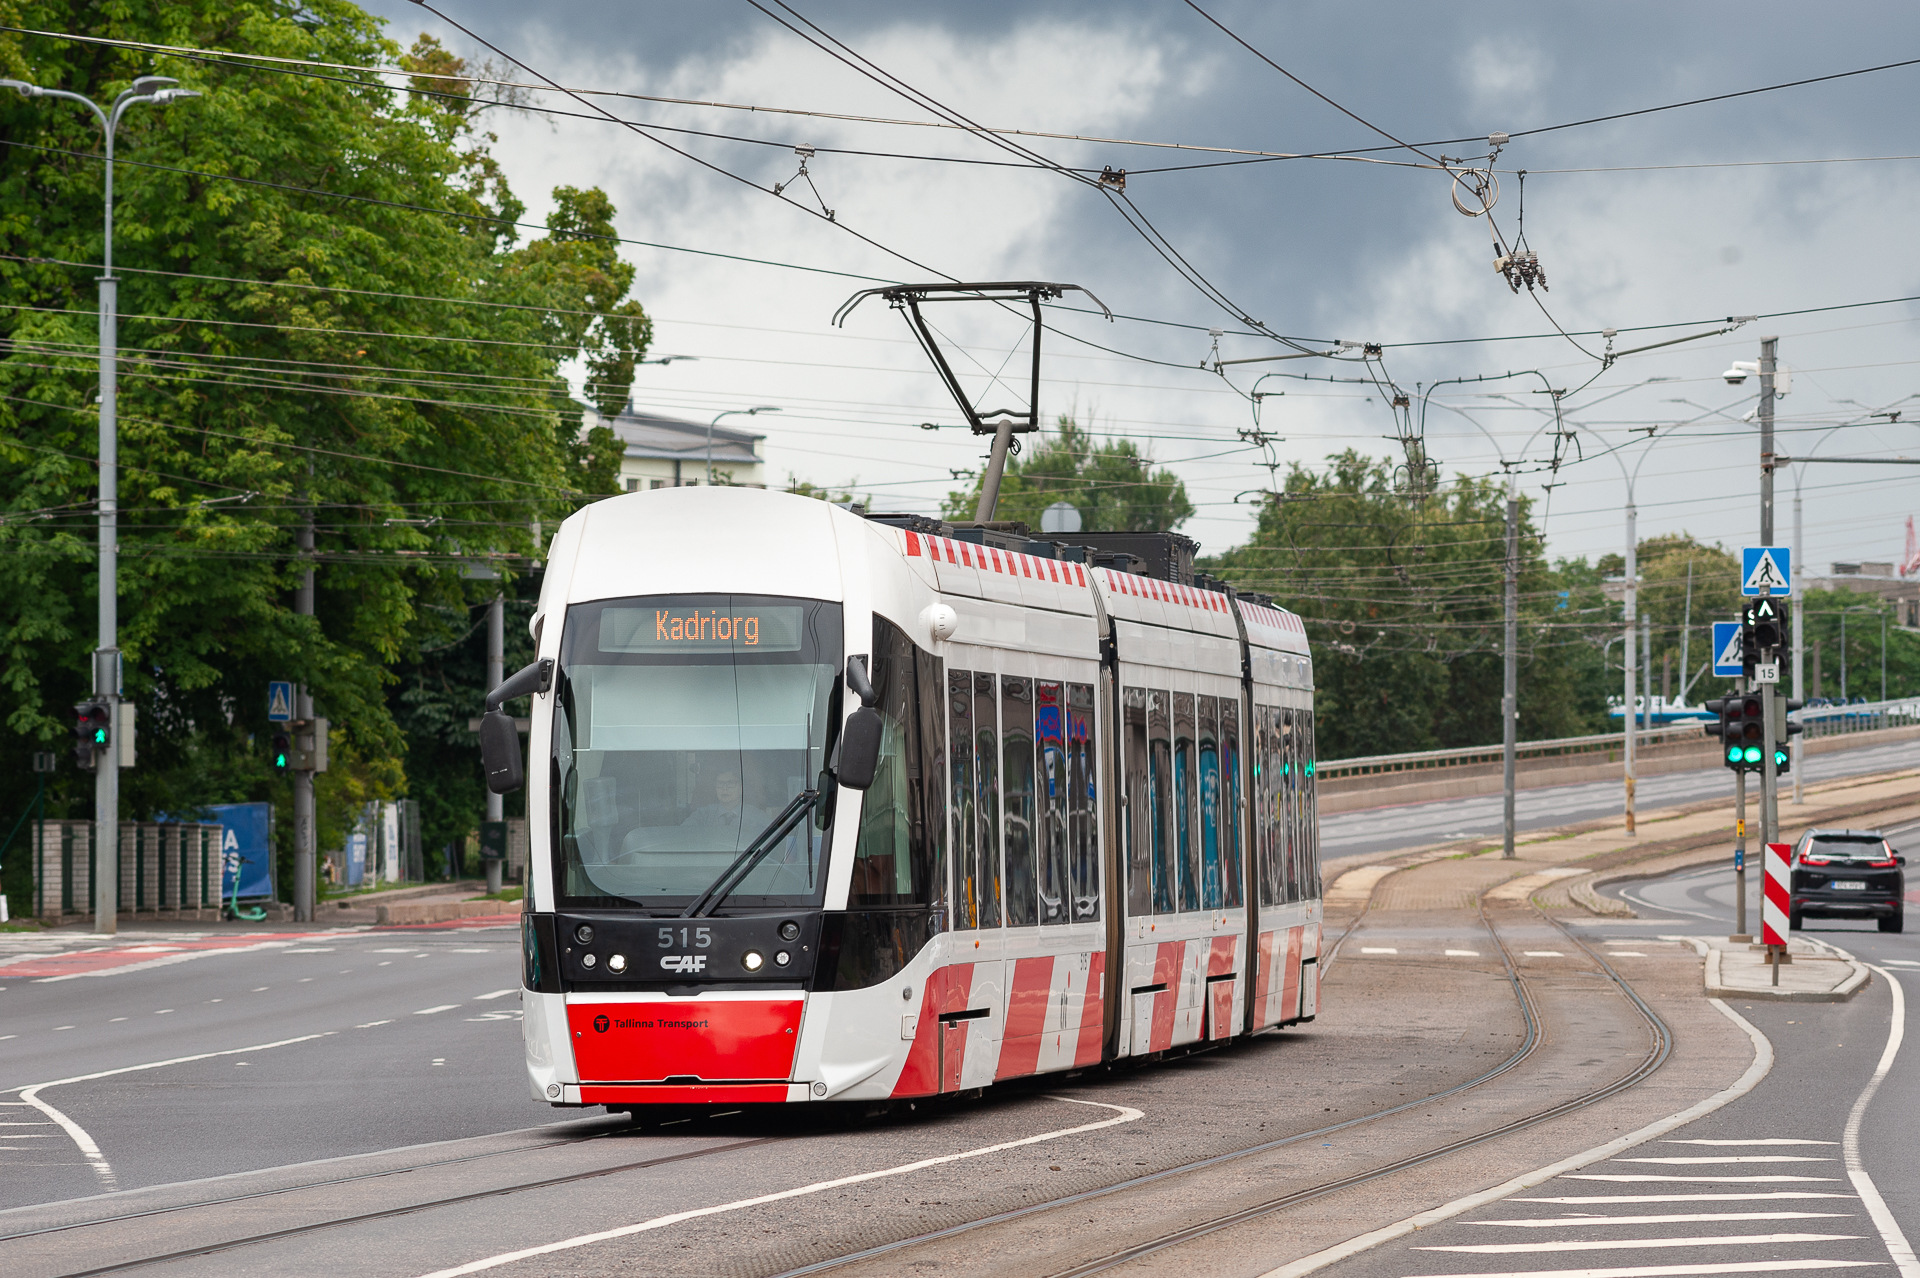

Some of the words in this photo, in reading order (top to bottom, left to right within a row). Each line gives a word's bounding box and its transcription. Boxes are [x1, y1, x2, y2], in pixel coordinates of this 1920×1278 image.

[656, 610, 759, 645] Kadriorg
[1761, 668, 1775, 679] 15
[657, 927, 712, 948] 515
[660, 955, 707, 973] CAF
[614, 1018, 654, 1028] Tallinna
[657, 1019, 709, 1030] Transport
